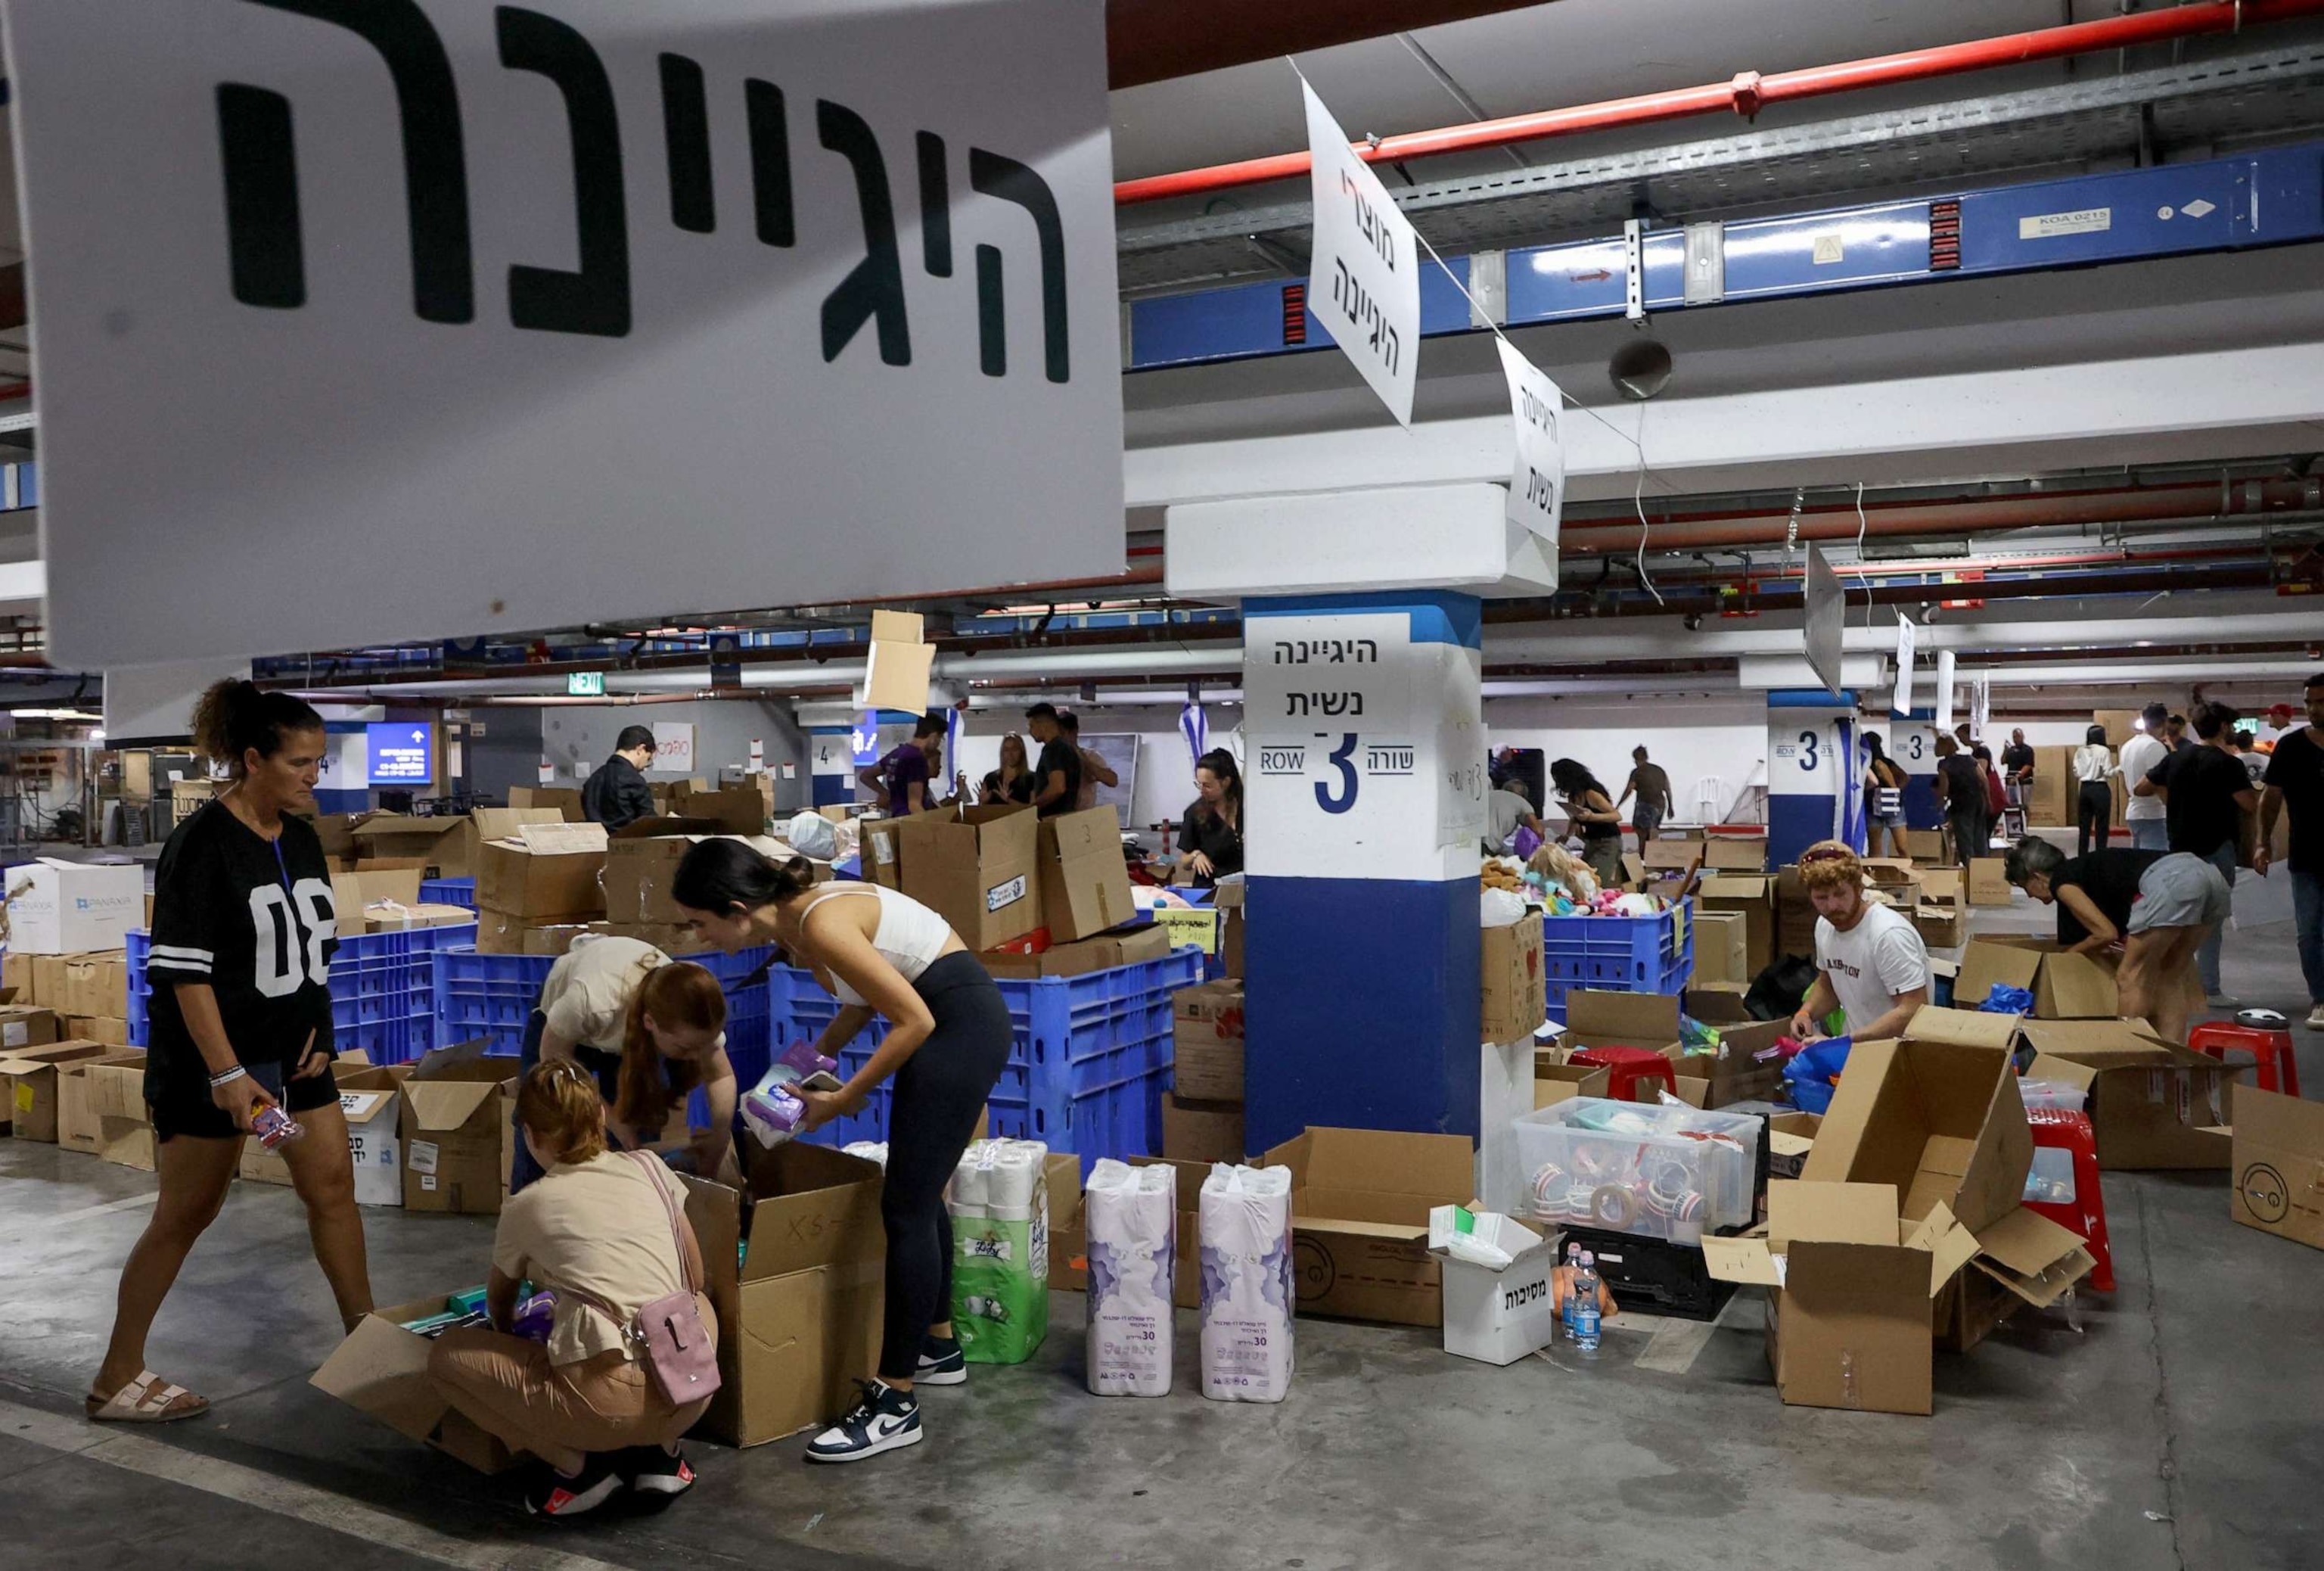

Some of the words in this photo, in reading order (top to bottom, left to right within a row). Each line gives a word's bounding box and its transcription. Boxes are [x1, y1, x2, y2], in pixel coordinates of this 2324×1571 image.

[215, 0, 1069, 384] היגיינה
[1341, 167, 1397, 273] מוצרי
[2040, 214, 2071, 226] KOA
[2074, 210, 2108, 222] 0215
[1333, 255, 1400, 378] היגיינה
[1521, 384, 1557, 444] היגיינה
[1528, 464, 1554, 515] נשית
[1274, 639, 1378, 665] היגיינה
[578, 671, 603, 695] EXIT
[1286, 690, 1364, 716] נשית
[820, 745, 829, 765] 4
[1799, 730, 1818, 771] 3
[1909, 735, 1922, 760] 3
[320, 756, 329, 774] 4
[1261, 751, 1305, 770] ROW
[1314, 733, 1359, 814] 3
[1368, 751, 1415, 770] שורה
[248, 877, 338, 998] 08
[1505, 1279, 1547, 1311] מסיכות
[1142, 1331, 1155, 1340] 30
[1254, 1336, 1267, 1346] 30
